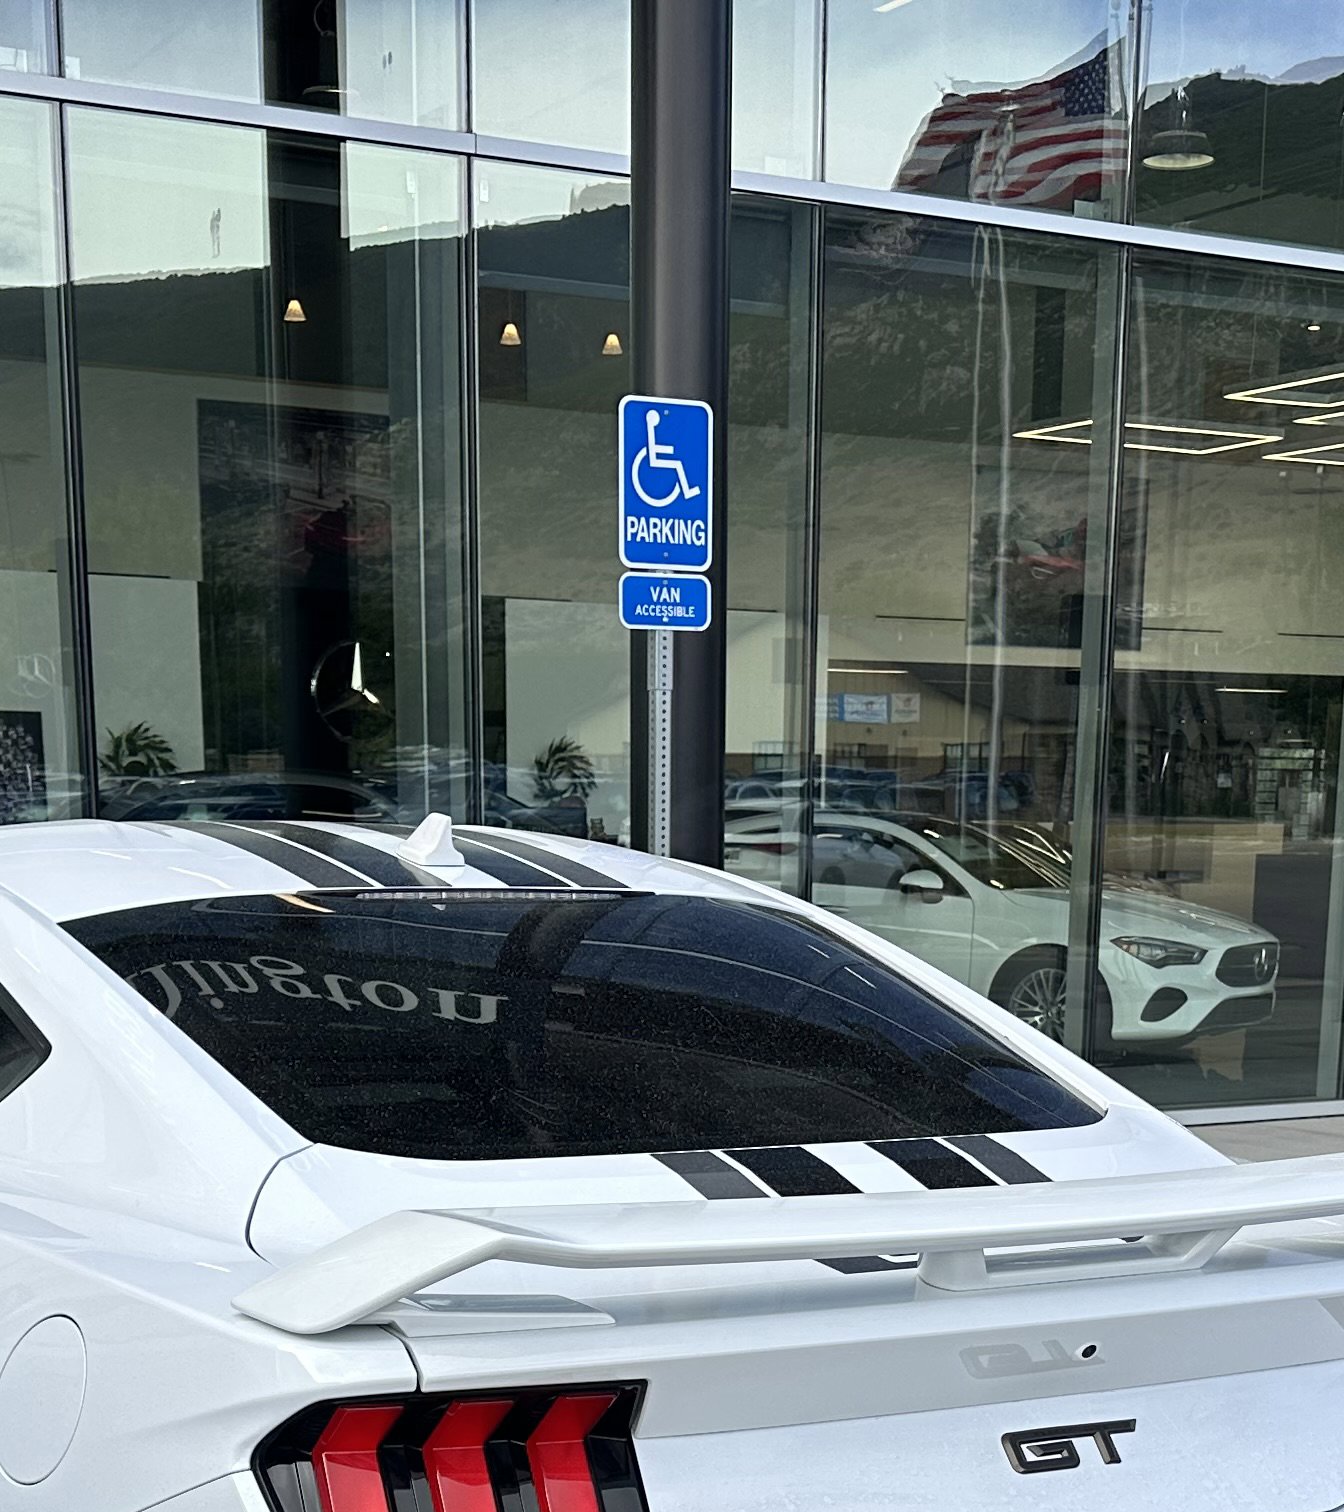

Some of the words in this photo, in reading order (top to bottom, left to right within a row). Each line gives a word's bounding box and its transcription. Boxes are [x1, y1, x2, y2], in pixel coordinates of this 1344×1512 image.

[626, 516, 706, 546] PARKING
[649, 586, 681, 603] VAN
[634, 604, 696, 618] ACCESSIBLE
[1001, 1418, 1137, 1475] GT
